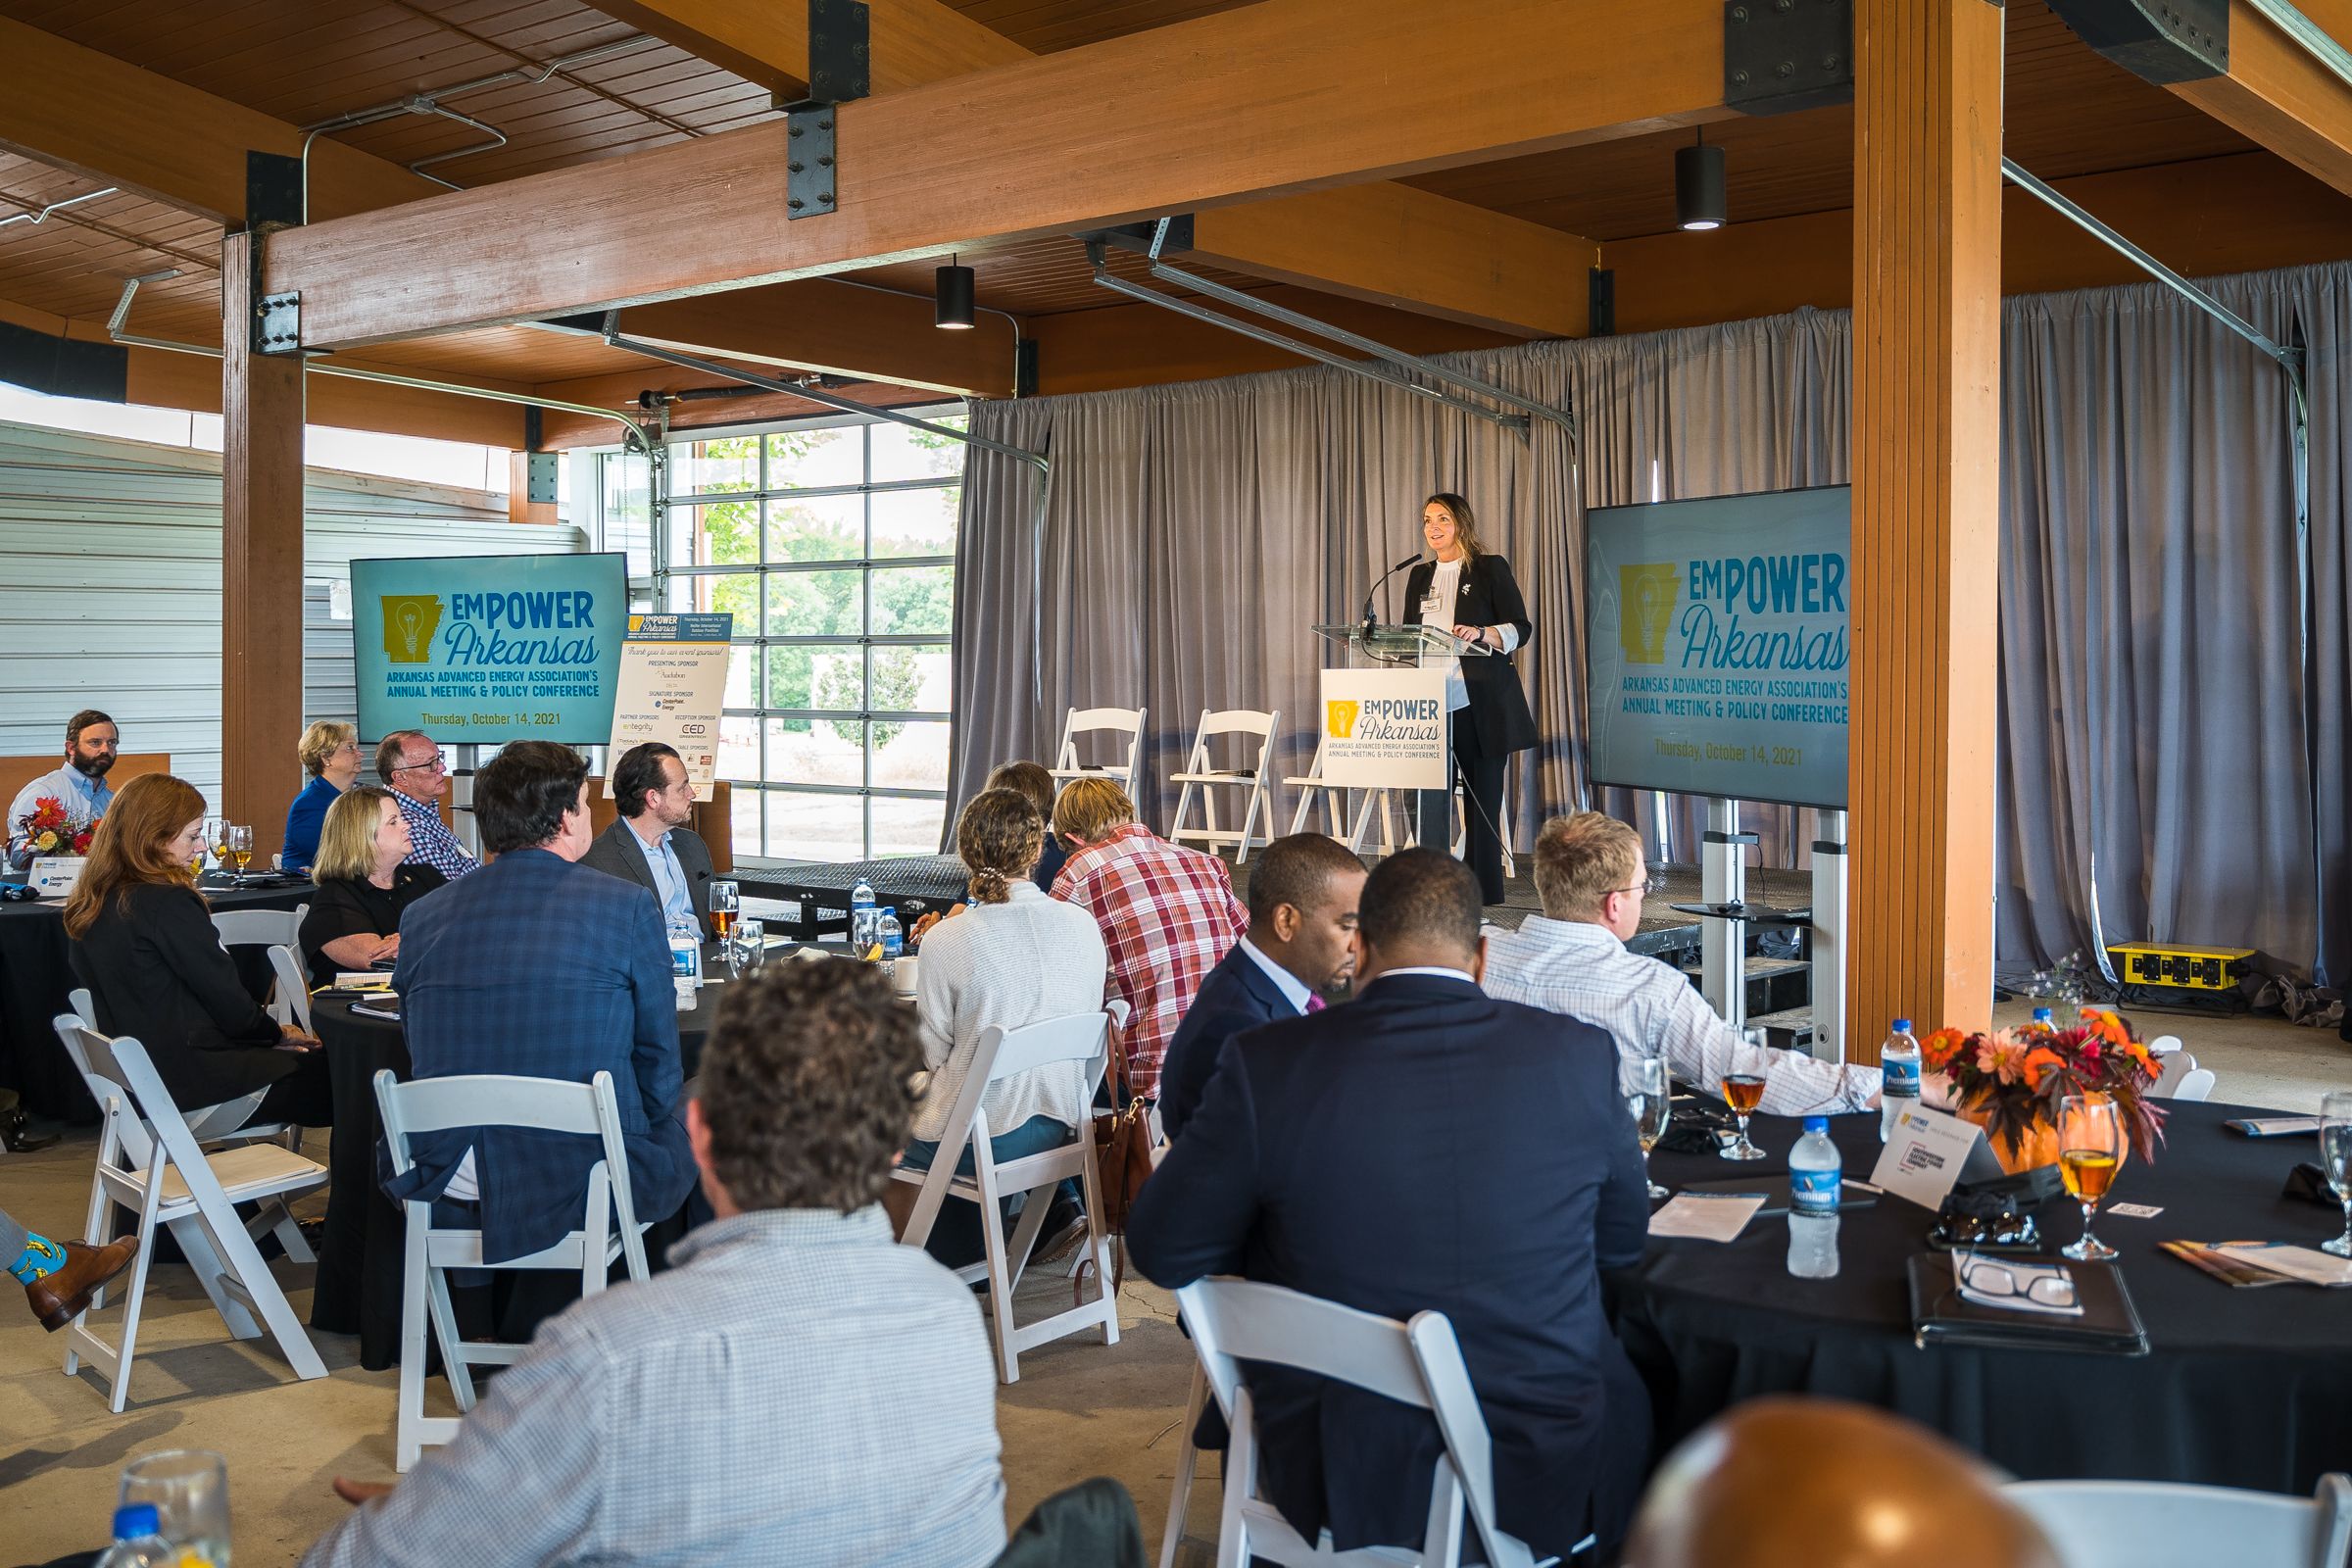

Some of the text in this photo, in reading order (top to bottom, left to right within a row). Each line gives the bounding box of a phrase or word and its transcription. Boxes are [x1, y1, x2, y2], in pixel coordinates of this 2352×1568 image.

[1690, 553, 1845, 614] EMPOWER
[452, 591, 594, 629] EMPOWER
[643, 622, 677, 632] Arkansas
[645, 615, 678, 624] EMPOWER
[445, 622, 600, 666] Arkansas
[1681, 603, 1850, 671] Arkansas
[627, 647, 646, 656] Thank
[696, 647, 724, 657] sponsors!
[386, 670, 599, 683] ARKANSAS ADVANCED ENERGY ASSOCIATION'S
[387, 685, 600, 698] ANNUAL MEETING & POLICY CONFERENCE
[1622, 676, 1847, 700] ARKANSAS ADVANCED ENERGY ASSOCIATION'S
[1364, 700, 1439, 720] EMPOWER
[1622, 698, 1848, 724] ANNUAL MEETING & POLICY CONFERENCE
[421, 713, 561, 726] Thursday, October 14, 2021
[1359, 715, 1441, 740] Arkansas
[682, 724, 706, 734] CED
[1654, 738, 1802, 766] Thursday, October 14, 2021
[1886, 1074, 1918, 1085] Premium
[1791, 1187, 1831, 1202] Premium
